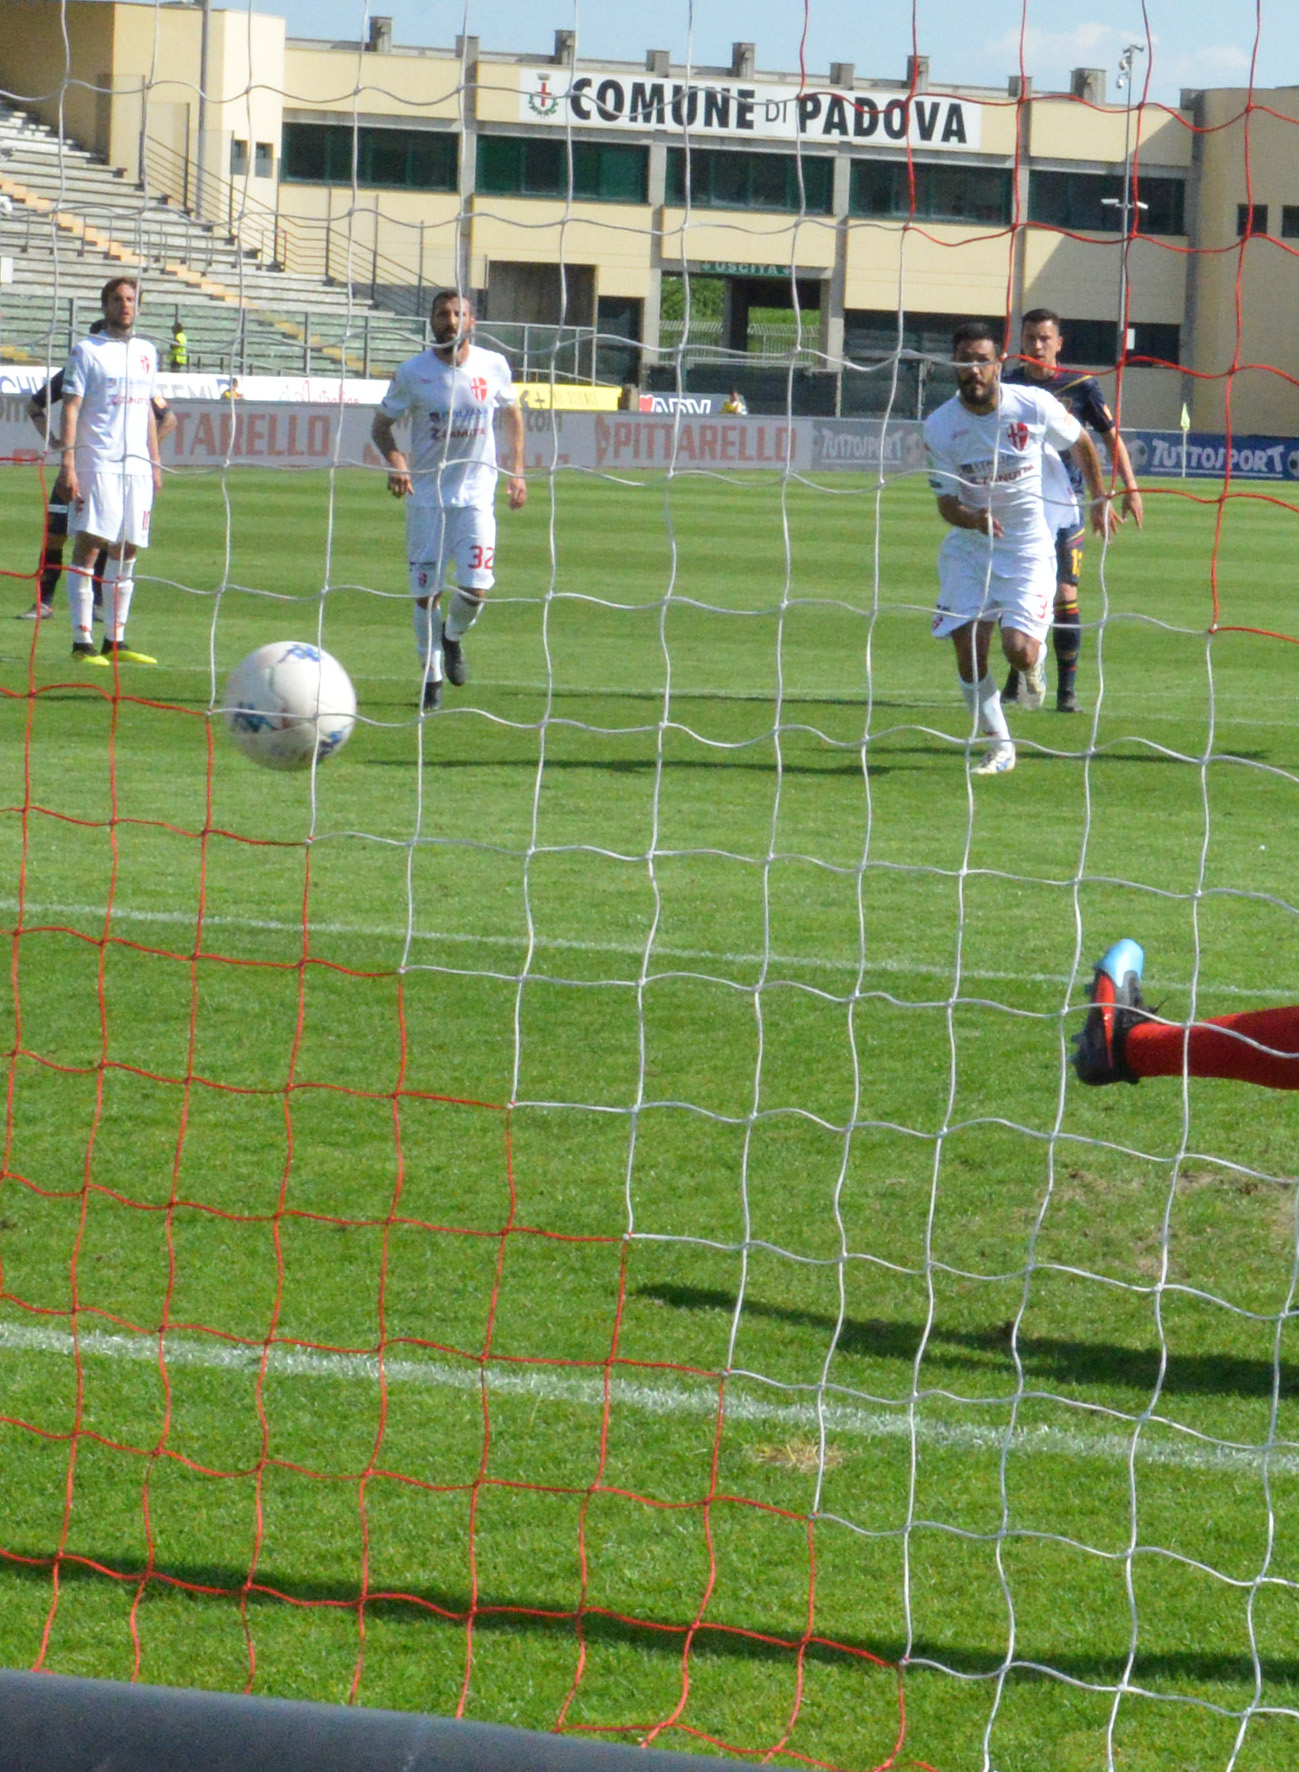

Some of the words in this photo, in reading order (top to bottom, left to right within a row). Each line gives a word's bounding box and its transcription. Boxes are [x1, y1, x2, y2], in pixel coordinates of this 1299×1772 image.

[570, 77, 756, 130] COMUNE
[765, 98, 788, 124] DI
[799, 91, 968, 145] PADOVA
[714, 262, 778, 276] USCITA
[613, 421, 798, 462] PITTARELLO
[1152, 438, 1285, 473] TUTTOSPORT
[467, 545, 495, 570] 32
